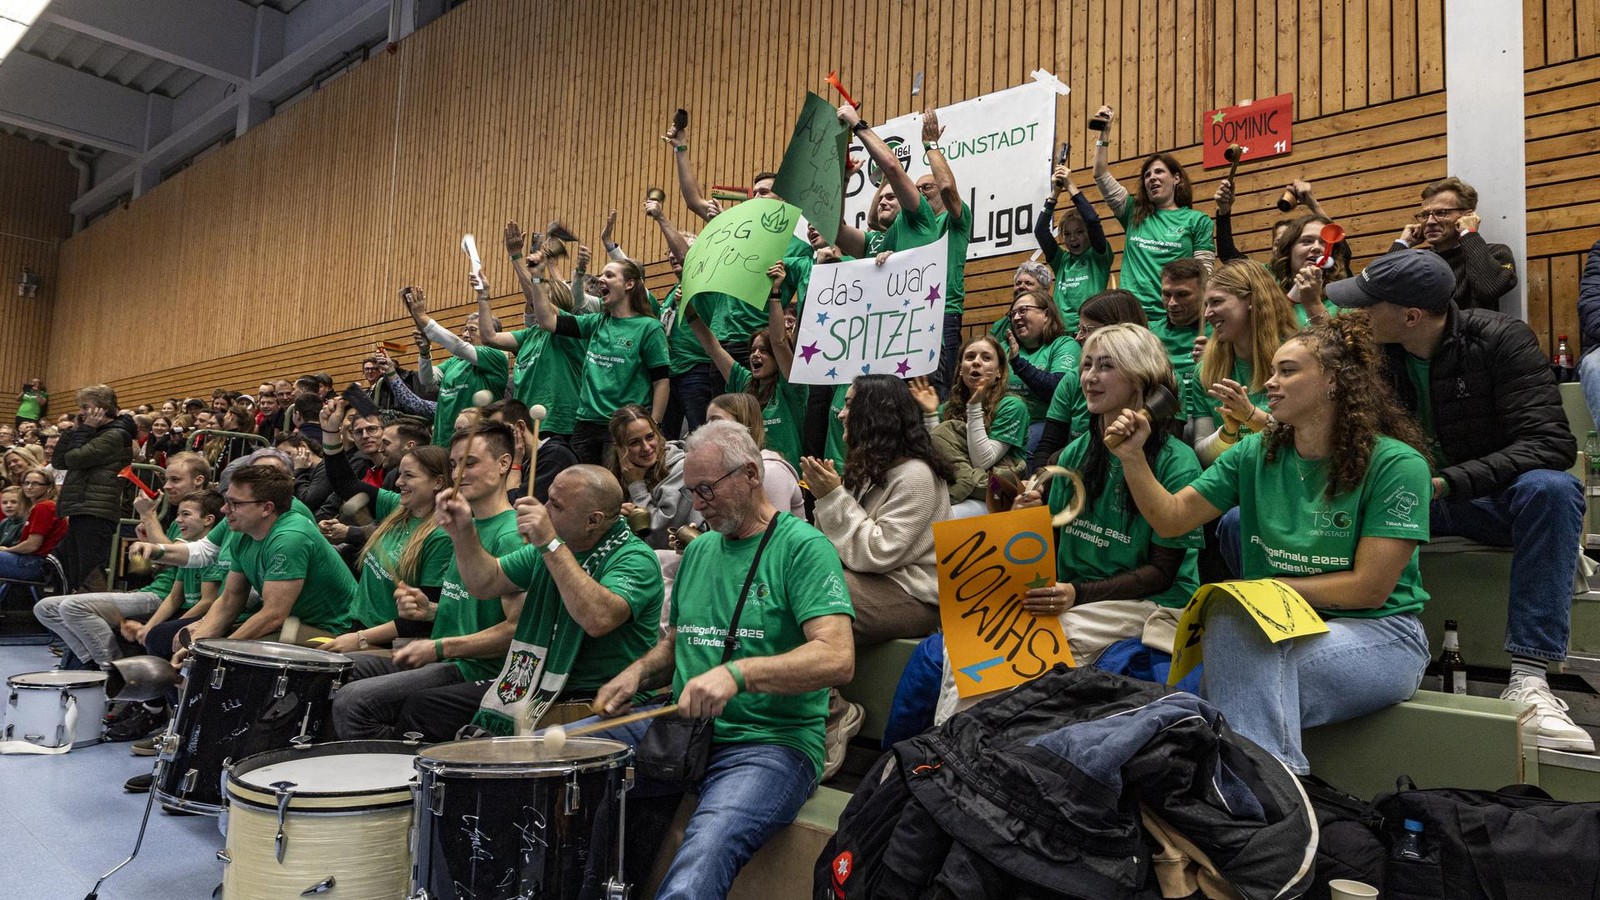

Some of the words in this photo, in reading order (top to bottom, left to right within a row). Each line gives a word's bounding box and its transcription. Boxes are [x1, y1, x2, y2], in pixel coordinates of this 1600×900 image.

[1212, 109, 1279, 147] DOMINIC
[894, 144, 911, 157] 1861
[1273, 139, 1287, 154] 11
[969, 186, 1034, 248] Liga
[705, 219, 753, 250] TSG
[705, 245, 761, 284] fire
[817, 267, 864, 306] das
[886, 262, 937, 298] war
[822, 305, 926, 362] SPITZE
[1311, 510, 1353, 530] TSG
[1104, 528, 1132, 544] 2025
[1311, 555, 1350, 566] 2025
